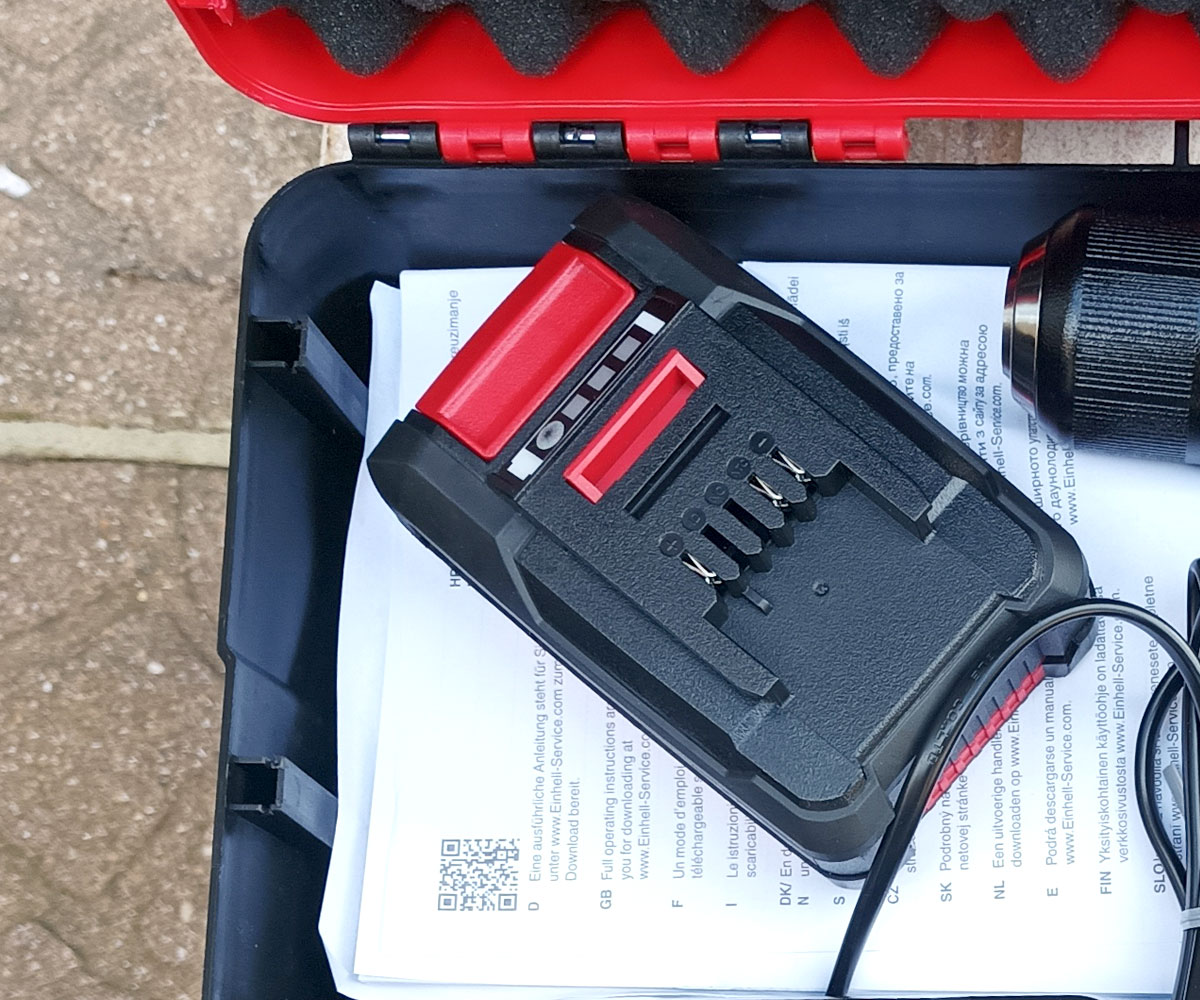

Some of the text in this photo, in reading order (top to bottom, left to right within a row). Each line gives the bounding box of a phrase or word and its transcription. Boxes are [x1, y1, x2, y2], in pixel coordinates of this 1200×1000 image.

[885, 288, 903, 372] предоставено
[894, 271, 904, 285] за
[904, 360, 915, 376] на
[957, 339, 969, 384] можна
[975, 323, 988, 383] адресою
[1061, 447, 1079, 525] www.Einhel
[533, 659, 546, 677] für
[1096, 665, 1106, 681] on
[533, 679, 546, 710] steht
[532, 713, 548, 772] Anleitung
[602, 721, 616, 793] instructions
[549, 687, 563, 846] www.Einhell-Service.com
[1010, 769, 1023, 786] op
[1058, 698, 1077, 865] www.Einhell-Service.com.
[1042, 679, 1058, 896] E Podrá descargarse un manual
[530, 775, 545, 851] ausführliche
[619, 739, 636, 880] you for downloading at
[639, 733, 651, 879] www.Einhell-Service.co
[955, 776, 971, 870] netovej stránke
[990, 777, 1006, 839] uitvoerige
[1095, 751, 1112, 863] Yksityiskohtainen
[1113, 754, 1131, 863] verkkosivustosta
[564, 777, 580, 881] Download bereit.
[602, 797, 618, 855] operating
[673, 822, 686, 858] mode
[690, 785, 707, 878] téléchargeable
[938, 810, 954, 871] Podrobný
[1008, 789, 1022, 867] downloaden
[528, 854, 542, 881] Eine
[548, 849, 560, 881] unter
[600, 859, 613, 880] Full
[672, 861, 685, 878] Un
[725, 862, 738, 877] Le
[779, 860, 792, 877] En
[991, 842, 1004, 868] Een
[599, 889, 612, 909] GB
[779, 881, 792, 905] DK/
[796, 896, 809, 905] N
[832, 895, 845, 905] S
[939, 881, 952, 902] SK
[993, 879, 1005, 899] NL
[1099, 871, 1112, 894] FIN
[527, 901, 539, 911] D
[671, 899, 683, 907] F
